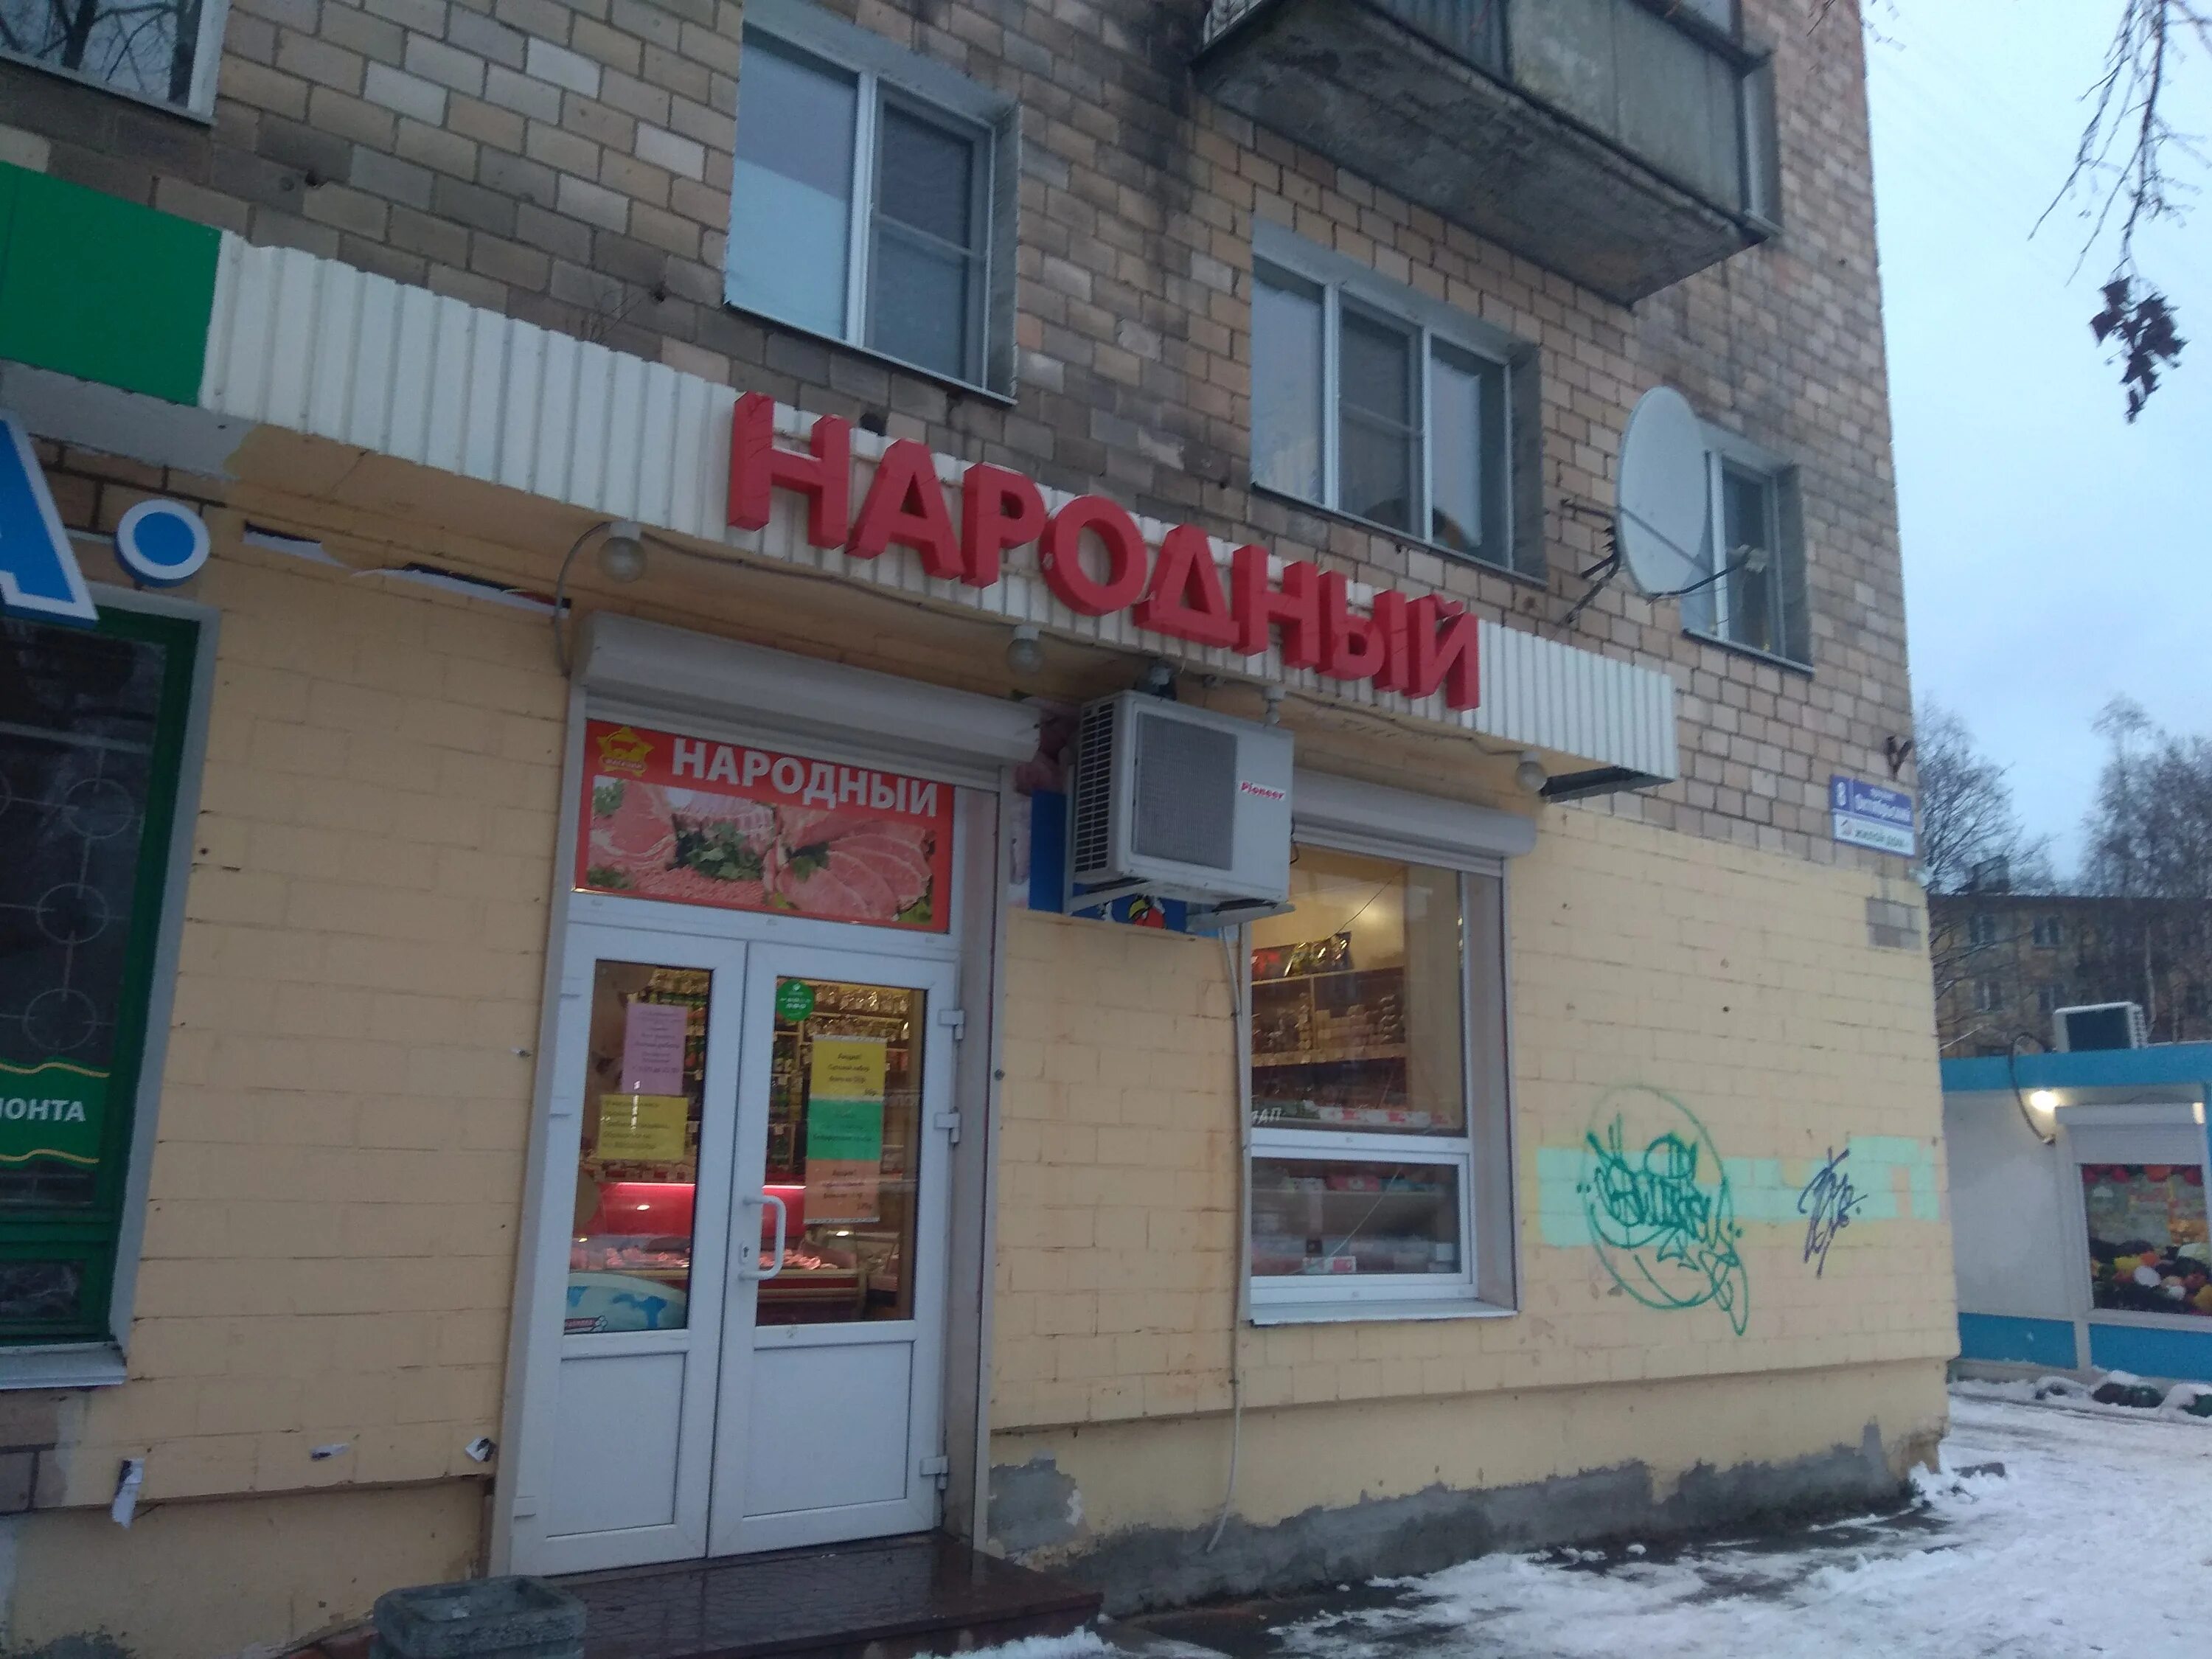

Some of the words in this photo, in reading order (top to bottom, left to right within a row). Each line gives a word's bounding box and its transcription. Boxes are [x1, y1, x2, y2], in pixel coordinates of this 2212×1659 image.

[727, 392, 1480, 711] НАРОДНЫЙ
[1240, 780, 1284, 800] Pioneer
[0, 1097, 86, 1121] ОНТА
